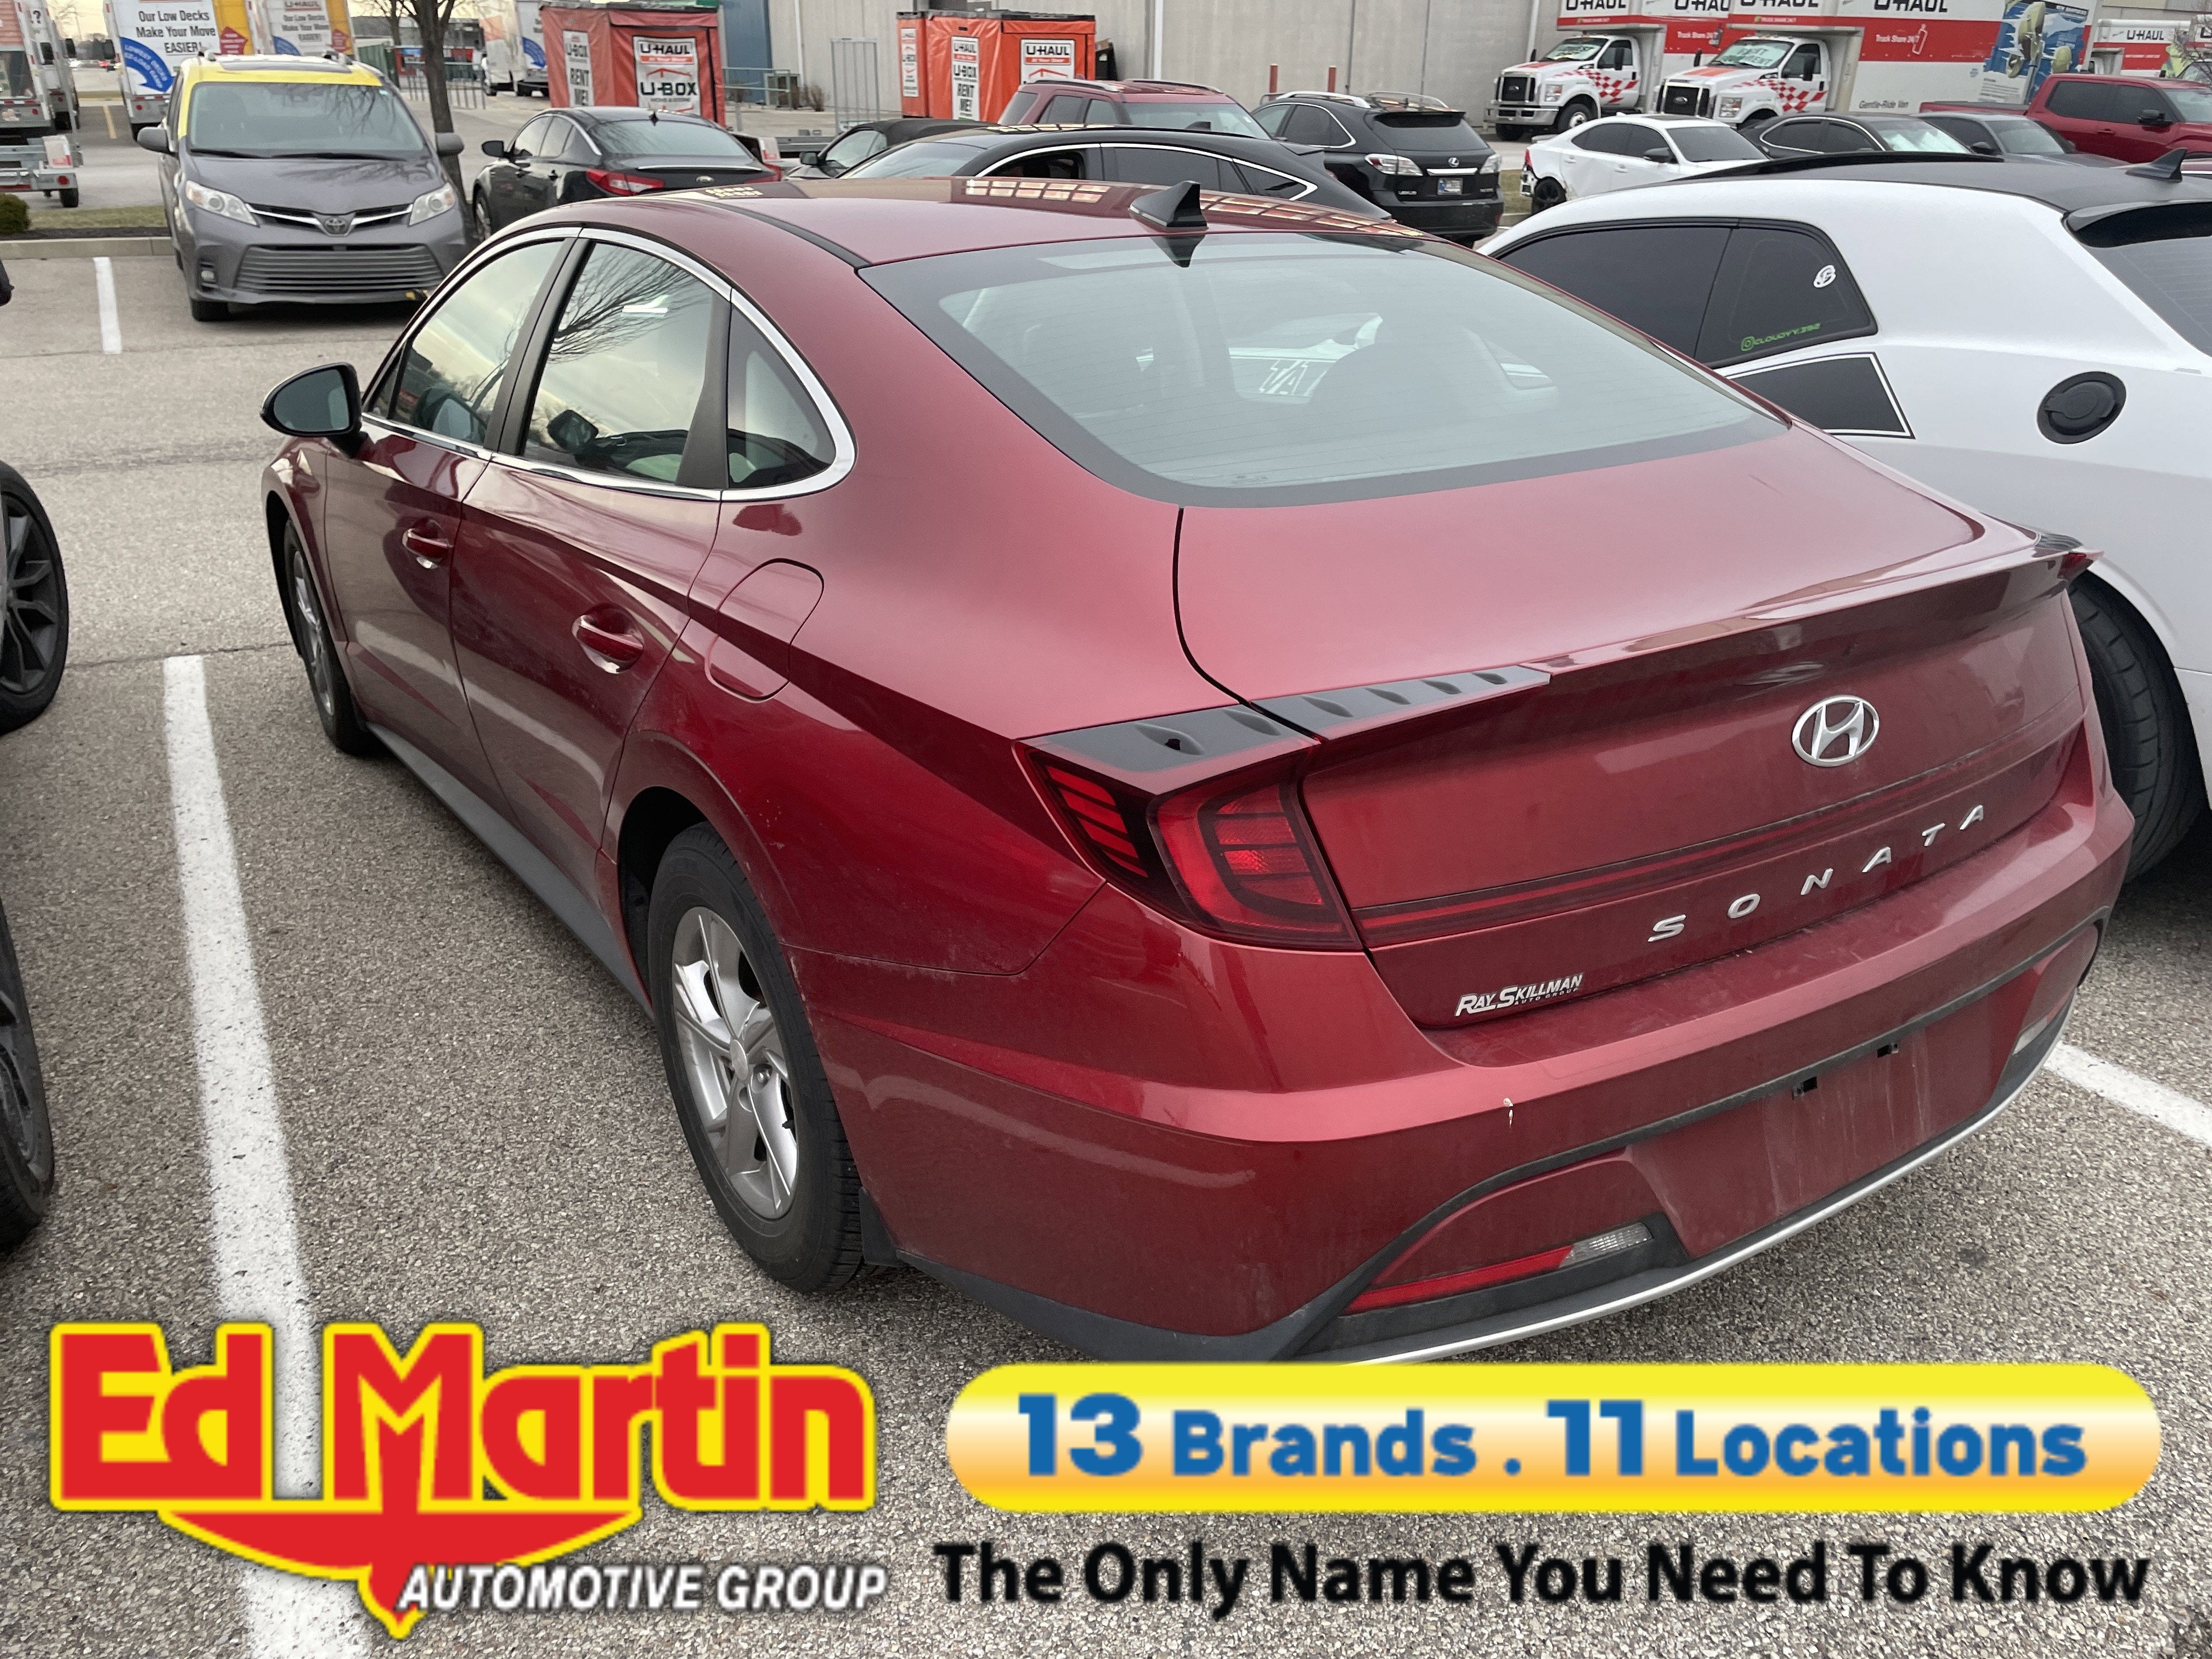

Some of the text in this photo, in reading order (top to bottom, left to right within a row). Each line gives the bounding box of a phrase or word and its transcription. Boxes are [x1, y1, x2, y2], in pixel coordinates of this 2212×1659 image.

[1675, 0, 1730, 11] U-HAU
[139, 9, 210, 22] Our Low Decks
[136, 26, 216, 38] Make Your Move
[2126, 30, 2164, 41] U-HAUL
[640, 43, 690, 54] U-HAUL
[1026, 46, 1069, 55] U-HAUL
[640, 82, 697, 95] U-BOX
[1647, 804, 1984, 943] SONATA
[1454, 974, 1583, 1017] RAY SKILLMAN
[1514, 988, 1580, 1006] AUTO GROUP
